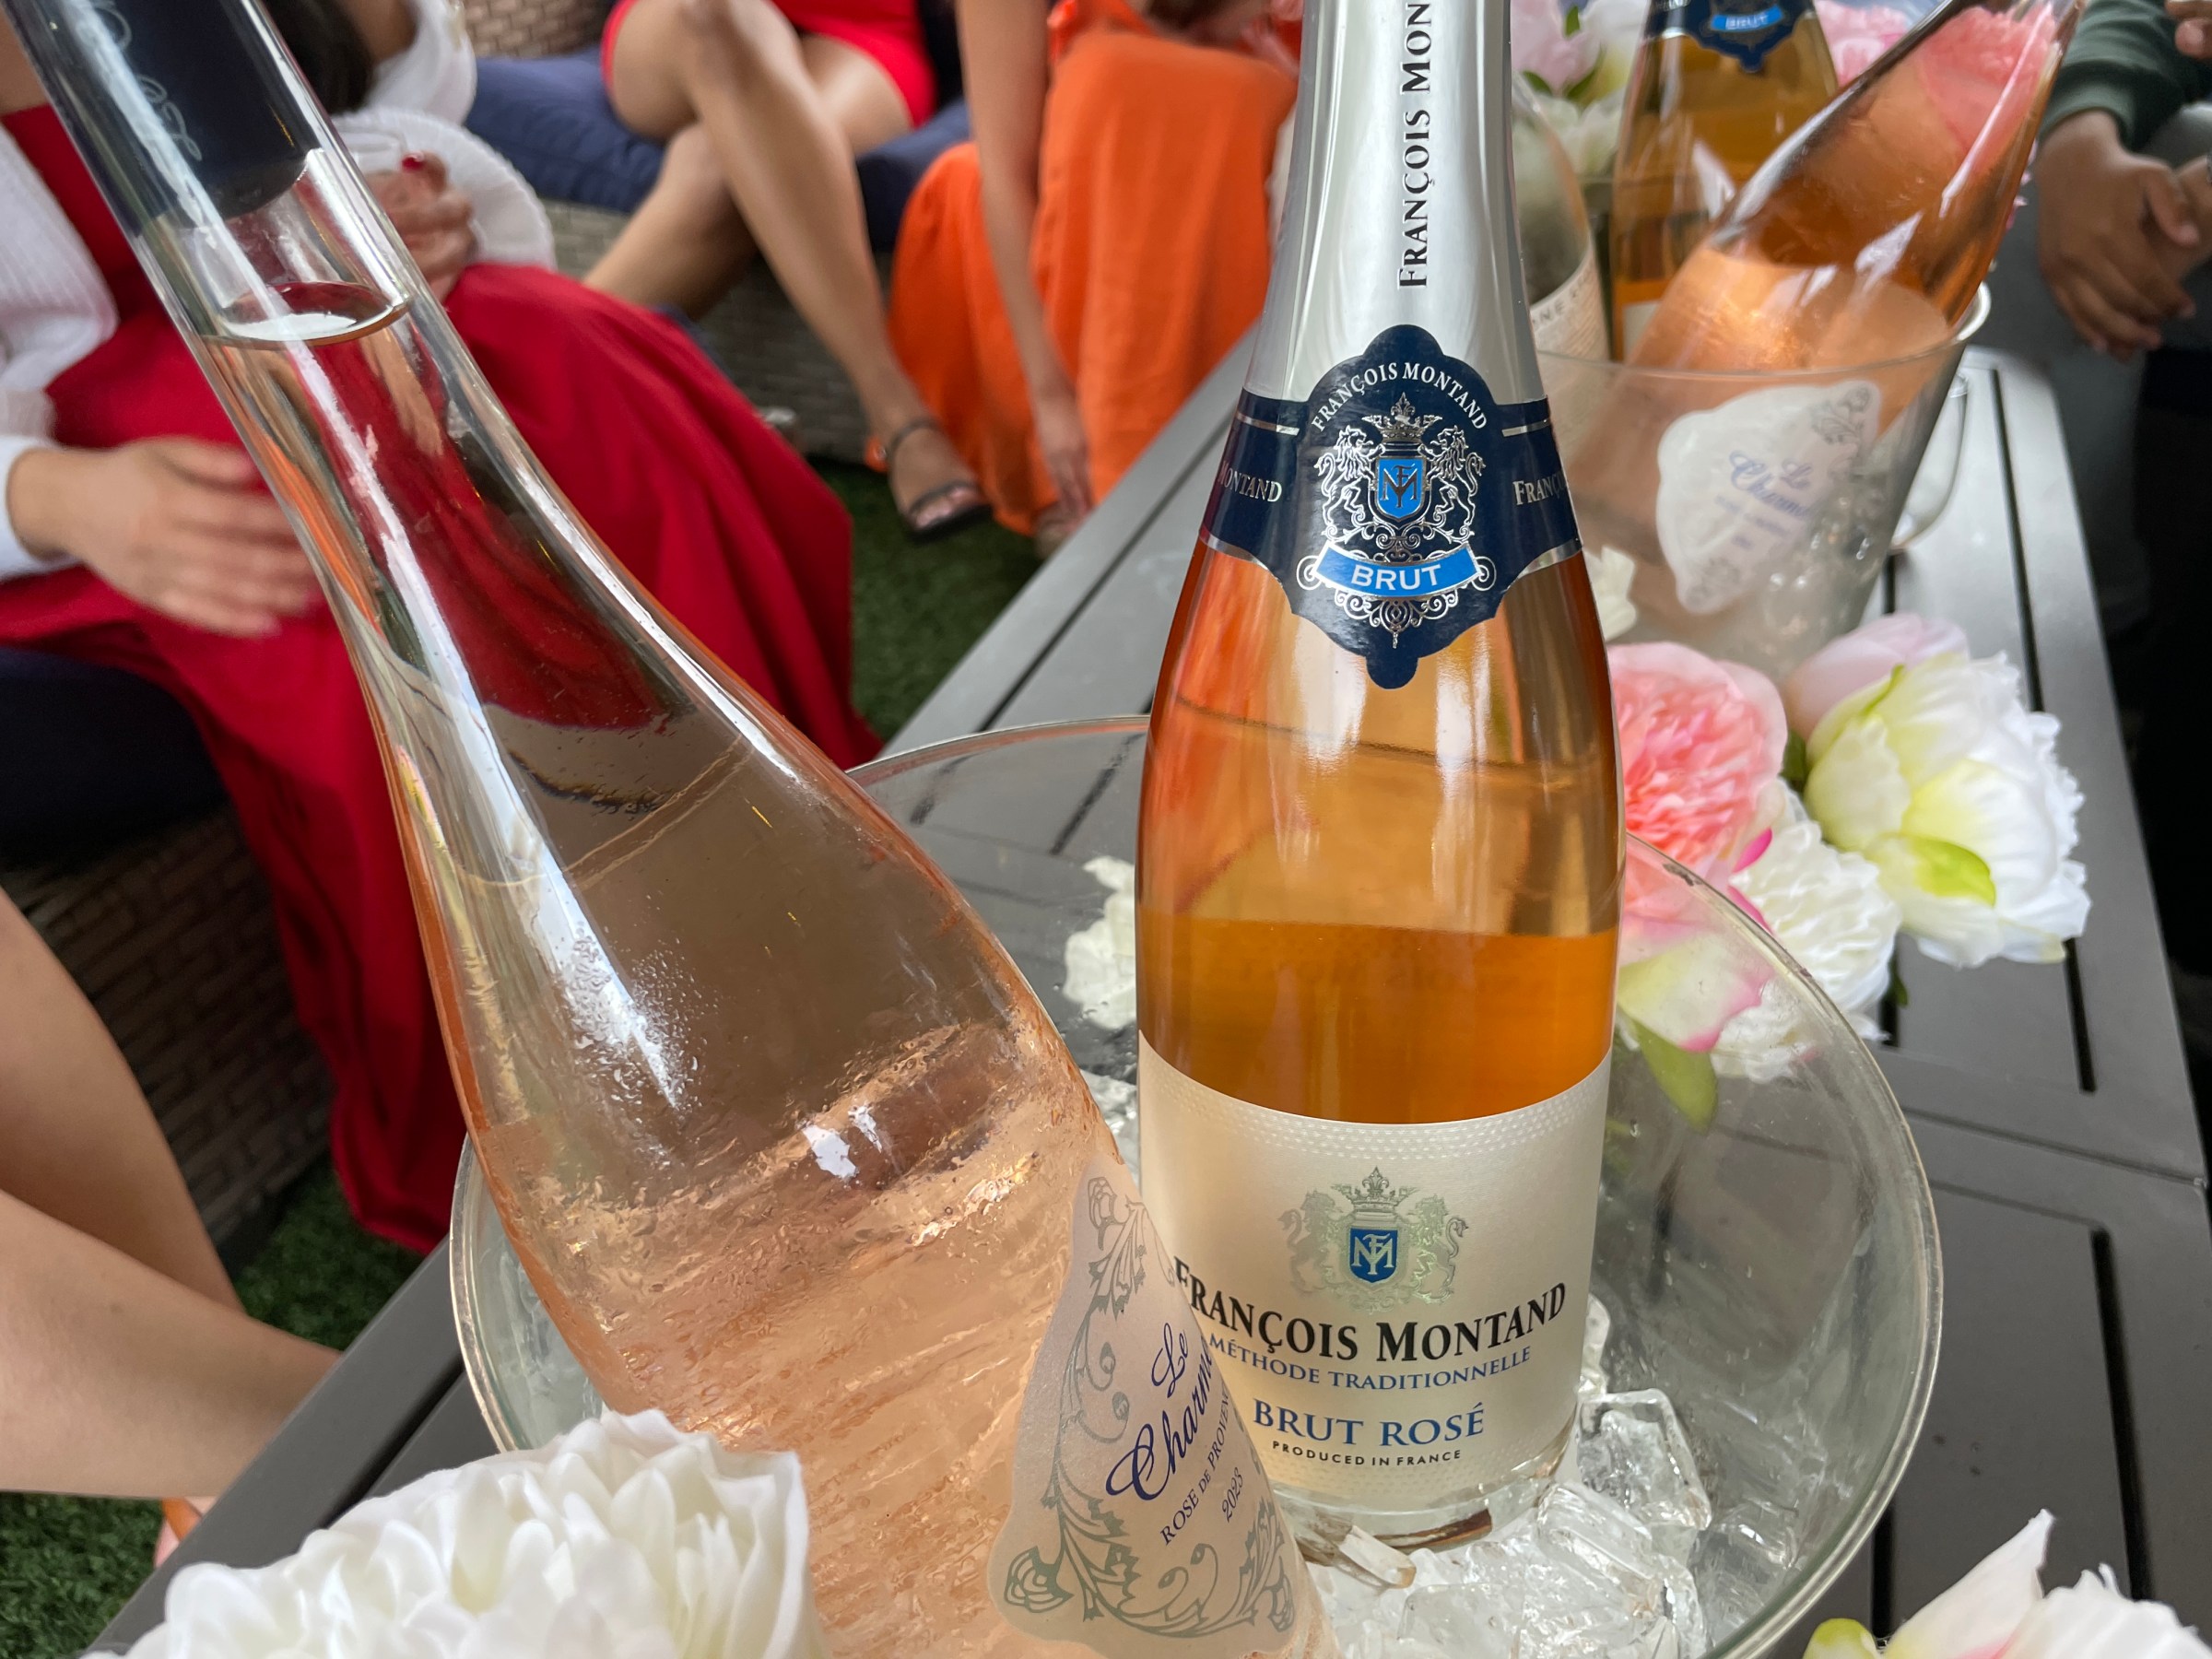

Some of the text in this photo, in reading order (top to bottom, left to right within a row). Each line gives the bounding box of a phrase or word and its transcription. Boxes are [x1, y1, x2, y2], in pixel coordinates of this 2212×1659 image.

[1397, 109, 1435, 289] FRANÇOIS
[1311, 361, 1488, 432] FRANÇOIS MONTAND
[1217, 461, 1283, 502] MONTAND
[1350, 563, 1441, 591] BRUT
[1174, 1255, 1566, 1362] FRANÇOIS MONTAND
[1150, 1321, 1189, 1399] Le
[1208, 1332, 1531, 1391] MÉTHODE TRADITIONNELLE
[1253, 1397, 1485, 1447] BRUT ROSÉ
[1272, 1440, 1462, 1466] PRODUCED IN FRANCE
[1198, 1472, 1212, 1496] DE
[1221, 1466, 1244, 1523] 2023
